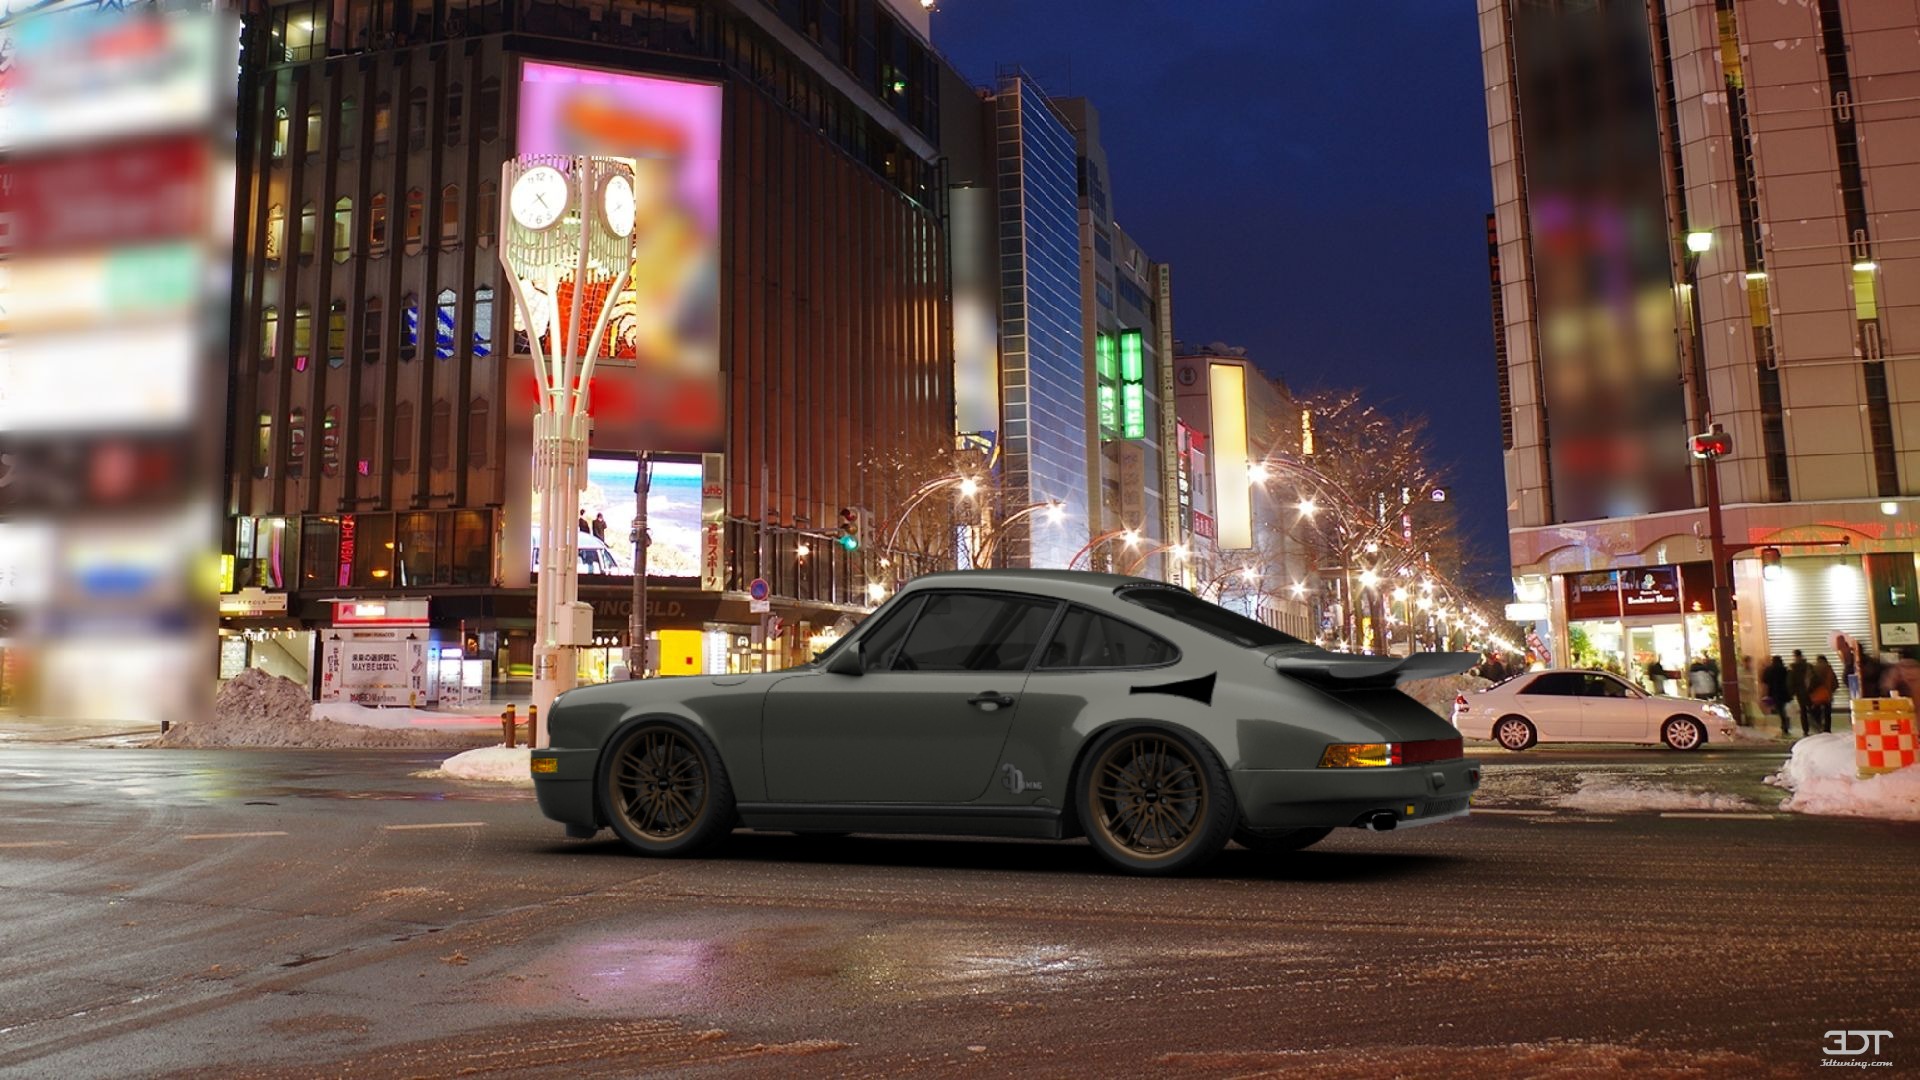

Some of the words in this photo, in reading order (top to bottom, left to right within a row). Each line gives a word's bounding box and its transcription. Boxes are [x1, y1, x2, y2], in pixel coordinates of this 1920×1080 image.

[536, 172, 545, 181] 12
[536, 215, 542, 225] 6
[703, 485, 723, 496] uhb
